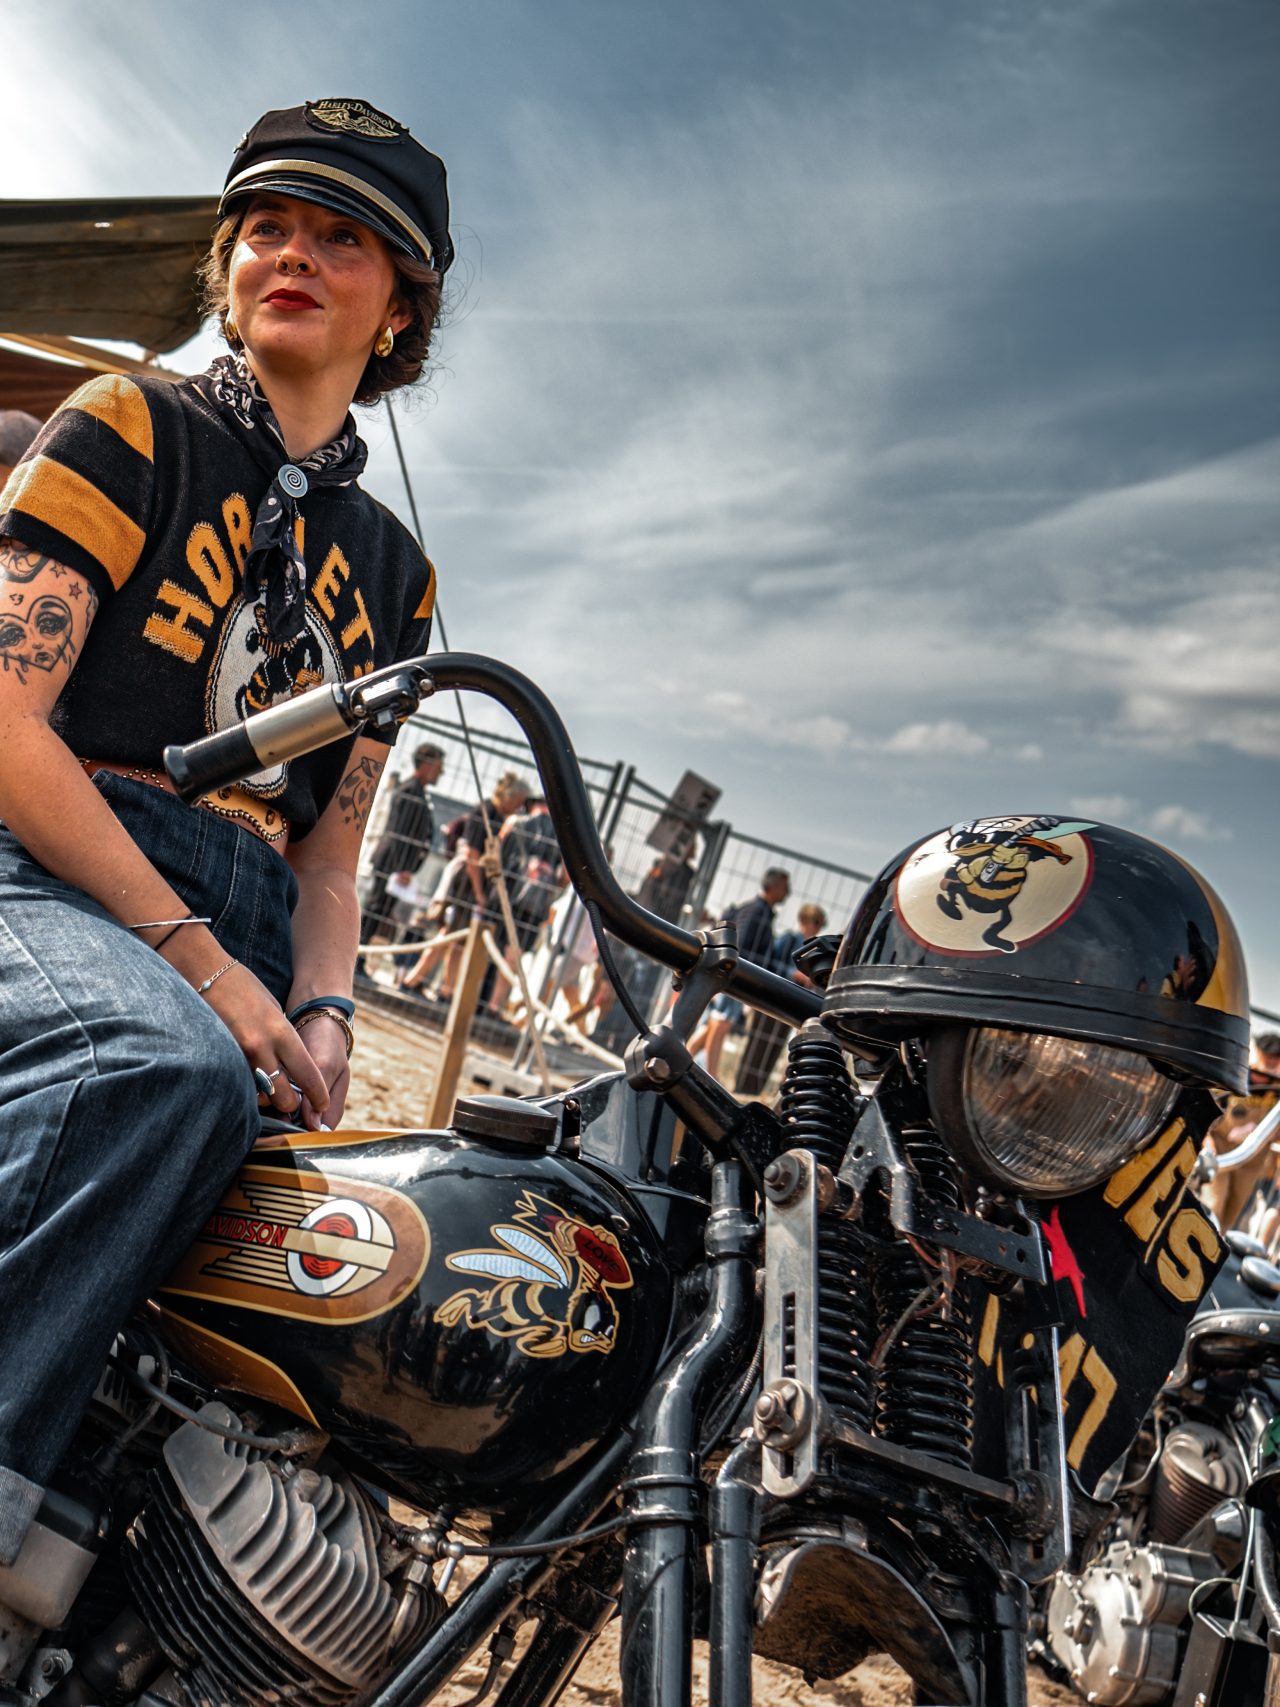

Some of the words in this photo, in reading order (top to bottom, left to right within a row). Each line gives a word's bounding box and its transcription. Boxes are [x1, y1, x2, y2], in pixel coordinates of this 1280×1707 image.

[141, 491, 375, 680] HORET
[204, 1214, 289, 1249] AVIDSON
[583, 1238, 620, 1272] LOVE
